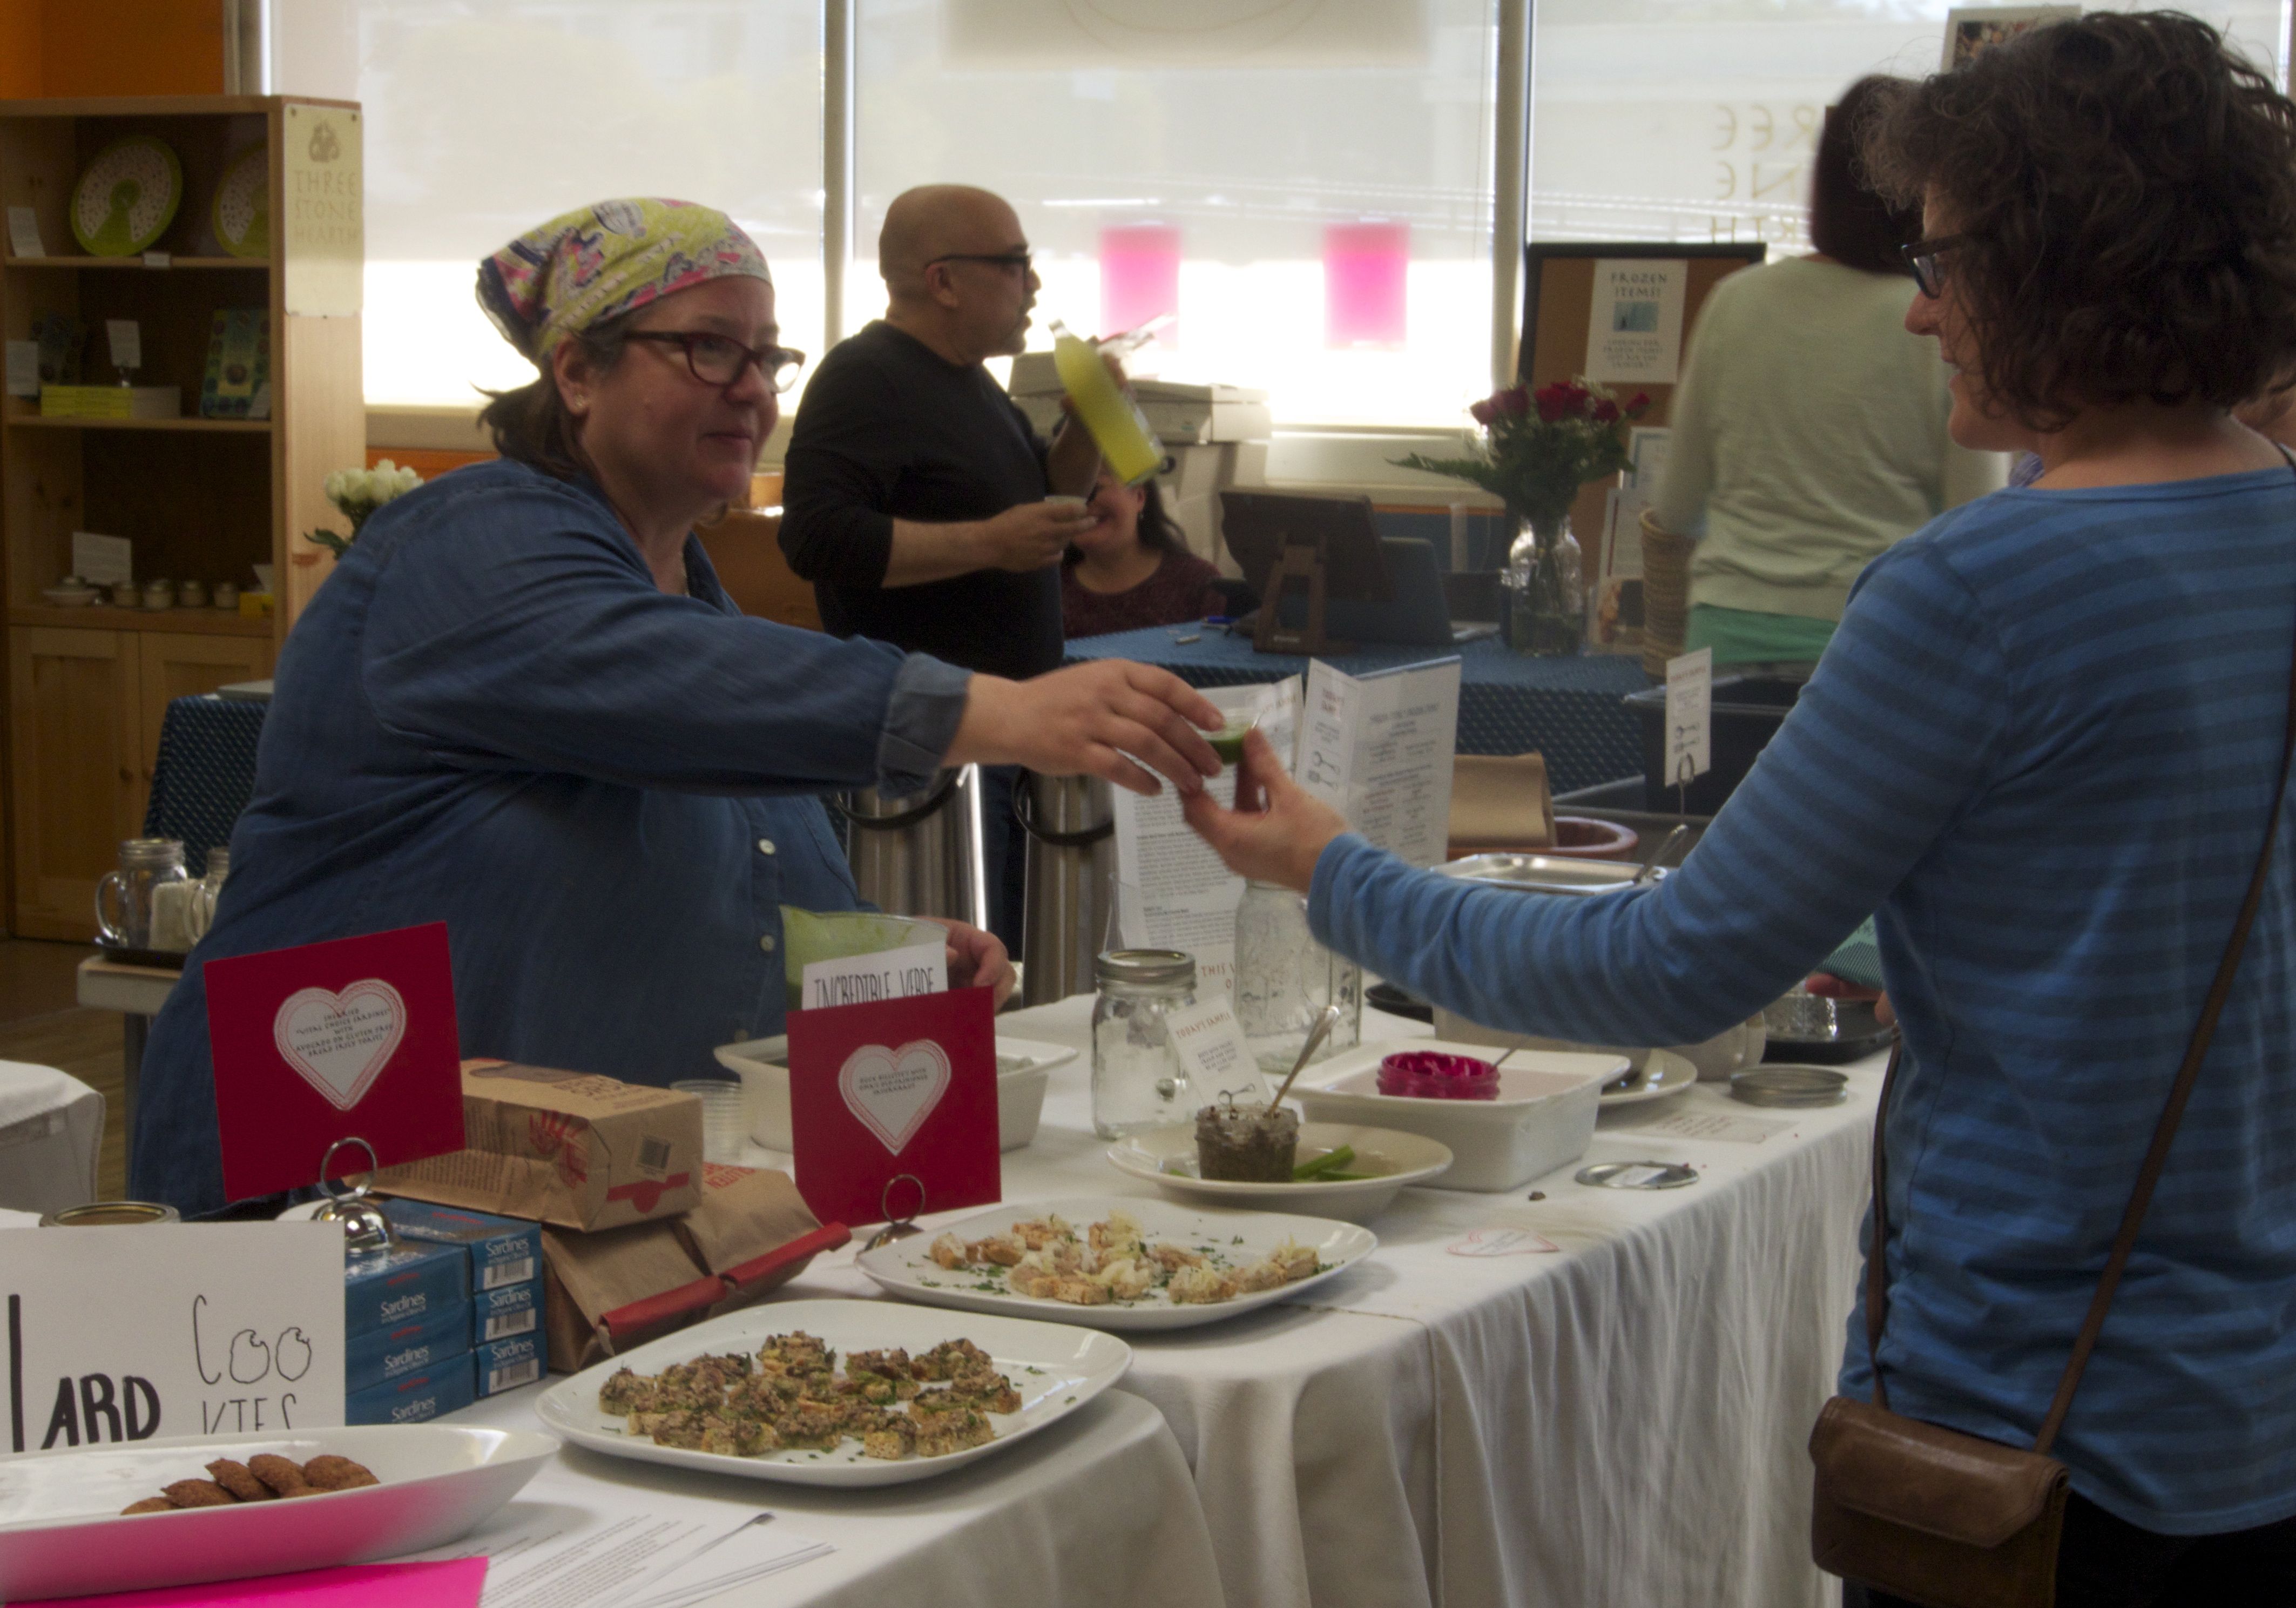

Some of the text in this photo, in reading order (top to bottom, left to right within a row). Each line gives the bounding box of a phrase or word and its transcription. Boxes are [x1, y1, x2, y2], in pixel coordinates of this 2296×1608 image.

[293, 170, 357, 196] THREE
[294, 199, 356, 222] STONE
[294, 225, 359, 245] HEARTH
[1611, 272, 1667, 284] FROZEN
[1200, 962, 1226, 978] THIS
[814, 967, 933, 1008] INCREDIBLE VERDE
[325, 1018, 350, 1030] CHOICE
[334, 1026, 353, 1034] WITH
[296, 1039, 330, 1051] AVOCADO
[345, 1028, 373, 1040] GLUTEN
[308, 1046, 333, 1057] BREAD
[485, 1237, 530, 1257] Sardines
[381, 1293, 426, 1315] Sardines
[489, 1288, 531, 1308] Sardines
[385, 1345, 429, 1368] Sardines
[491, 1340, 535, 1360] Sardines
[391, 1397, 436, 1420] Sardines
